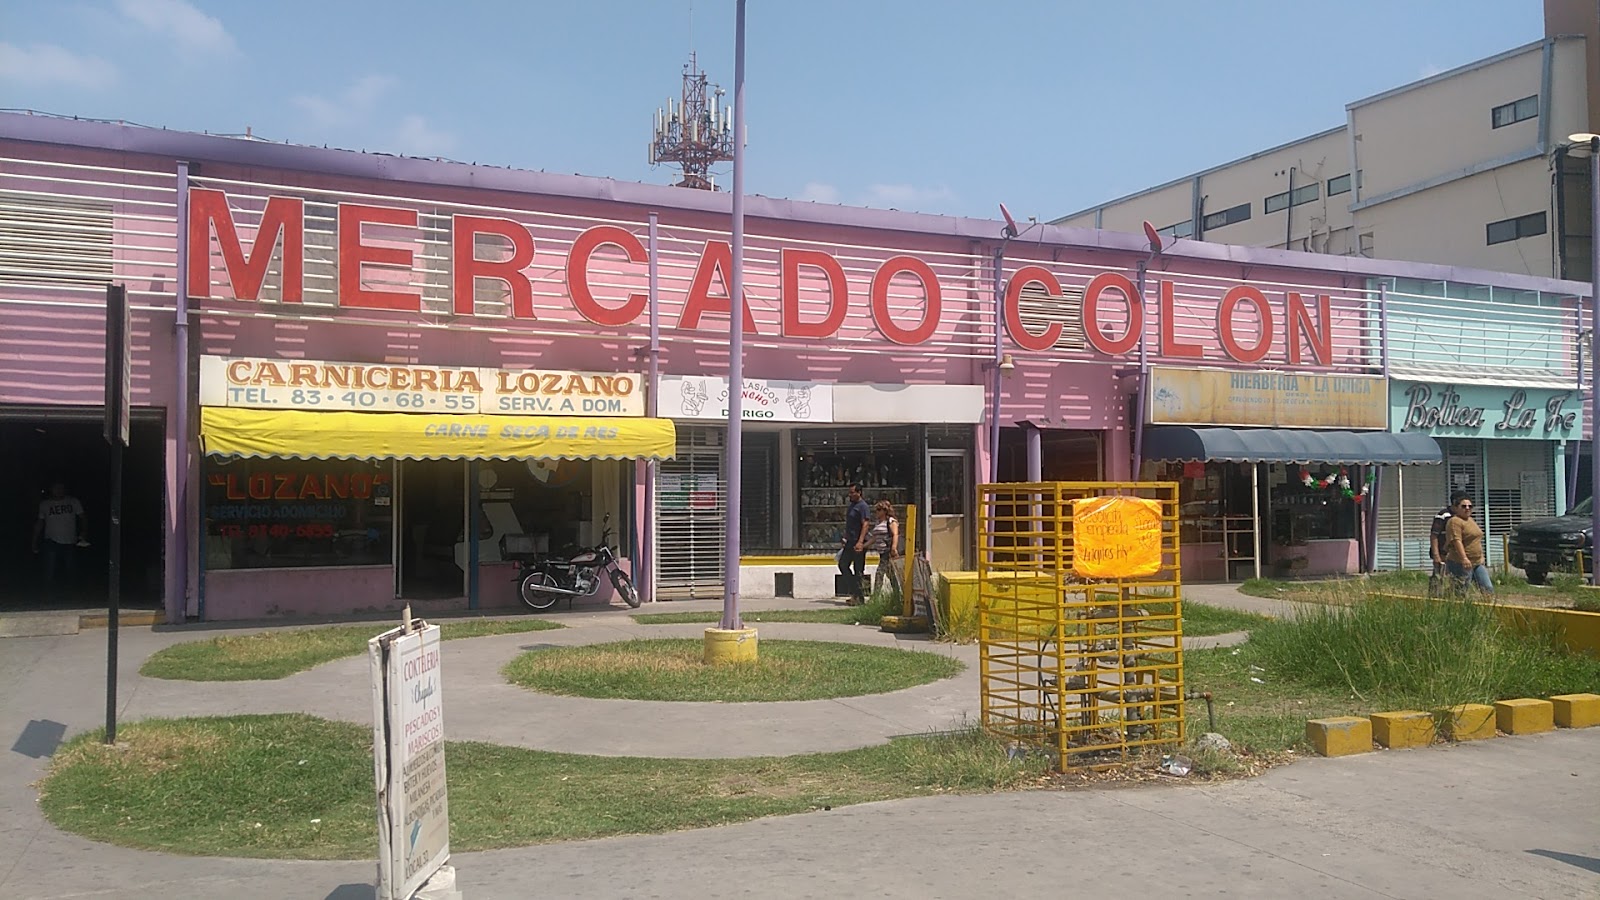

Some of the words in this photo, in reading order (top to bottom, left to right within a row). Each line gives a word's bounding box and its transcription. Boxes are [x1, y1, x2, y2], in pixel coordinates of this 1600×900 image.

[187, 187, 943, 345] MERCADO
[1003, 265, 1332, 367] COLON
[226, 360, 484, 393] CARNICERIA
[496, 371, 634, 398] LOZANO
[1231, 373, 1299, 391] HIERBERIA
[228, 387, 278, 403] TEL.
[741, 381, 780, 404] LASICOS
[499, 396, 554, 411] SERV.
[559, 398, 575, 412] A
[582, 399, 628, 413] DOM.
[1401, 383, 1486, 432] Botica
[1498, 389, 1537, 430] La
[1546, 390, 1577, 432] Fe
[424, 423, 490, 438] CARNE
[500, 424, 550, 439] SECA
[555, 426, 580, 438] DE
[584, 426, 619, 439] RES
[403, 649, 439, 682] COKTELERIA
[405, 707, 437, 738] PESCADOS
[405, 857, 422, 880] LOCAL
